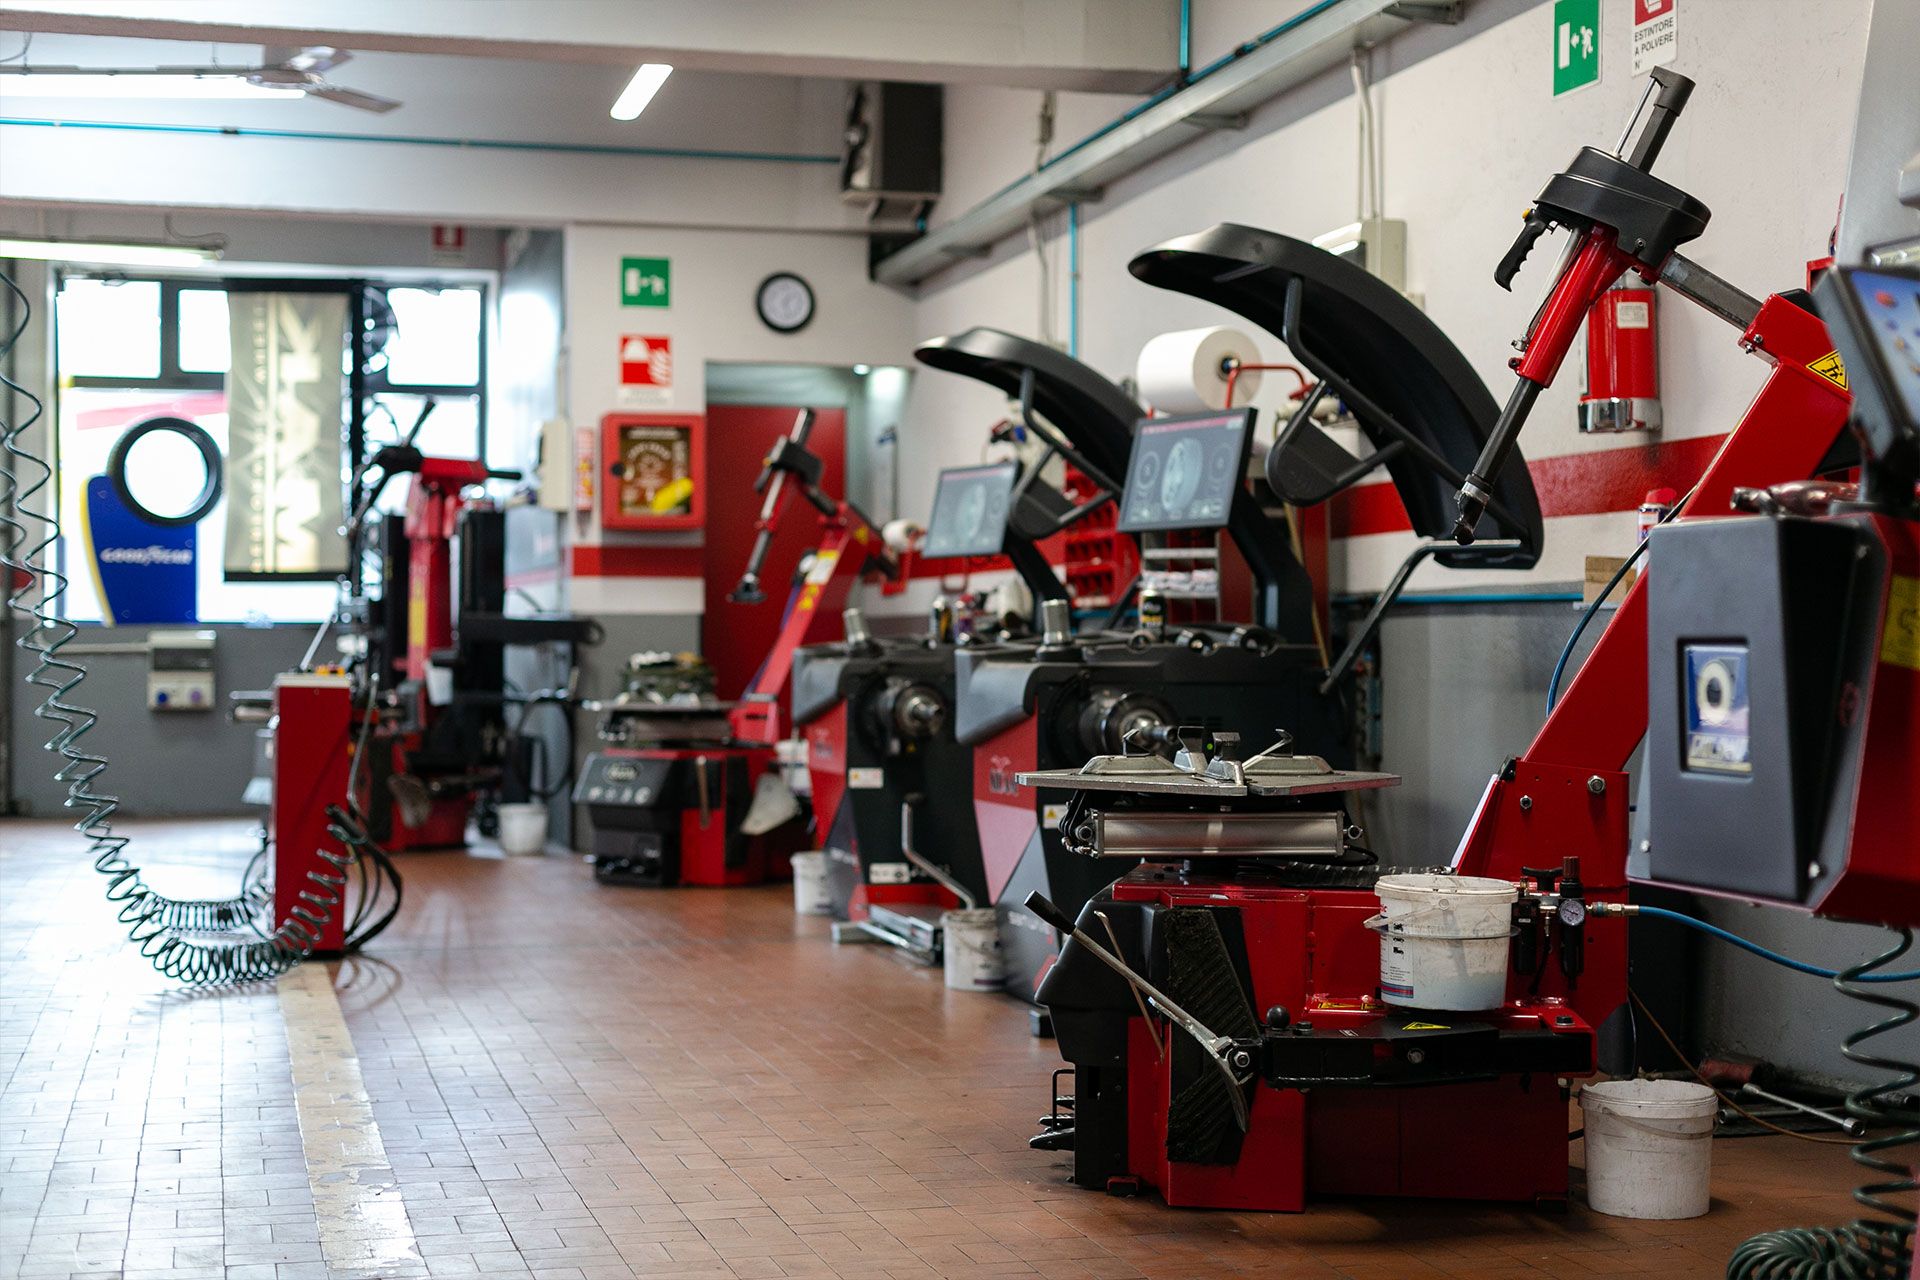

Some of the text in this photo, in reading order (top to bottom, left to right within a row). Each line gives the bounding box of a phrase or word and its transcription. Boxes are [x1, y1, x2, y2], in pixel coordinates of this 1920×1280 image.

[1635, 17, 1673, 42] ESTINTORE
[1635, 31, 1673, 56] A POLVERE
[275, 294, 321, 572] MAK
